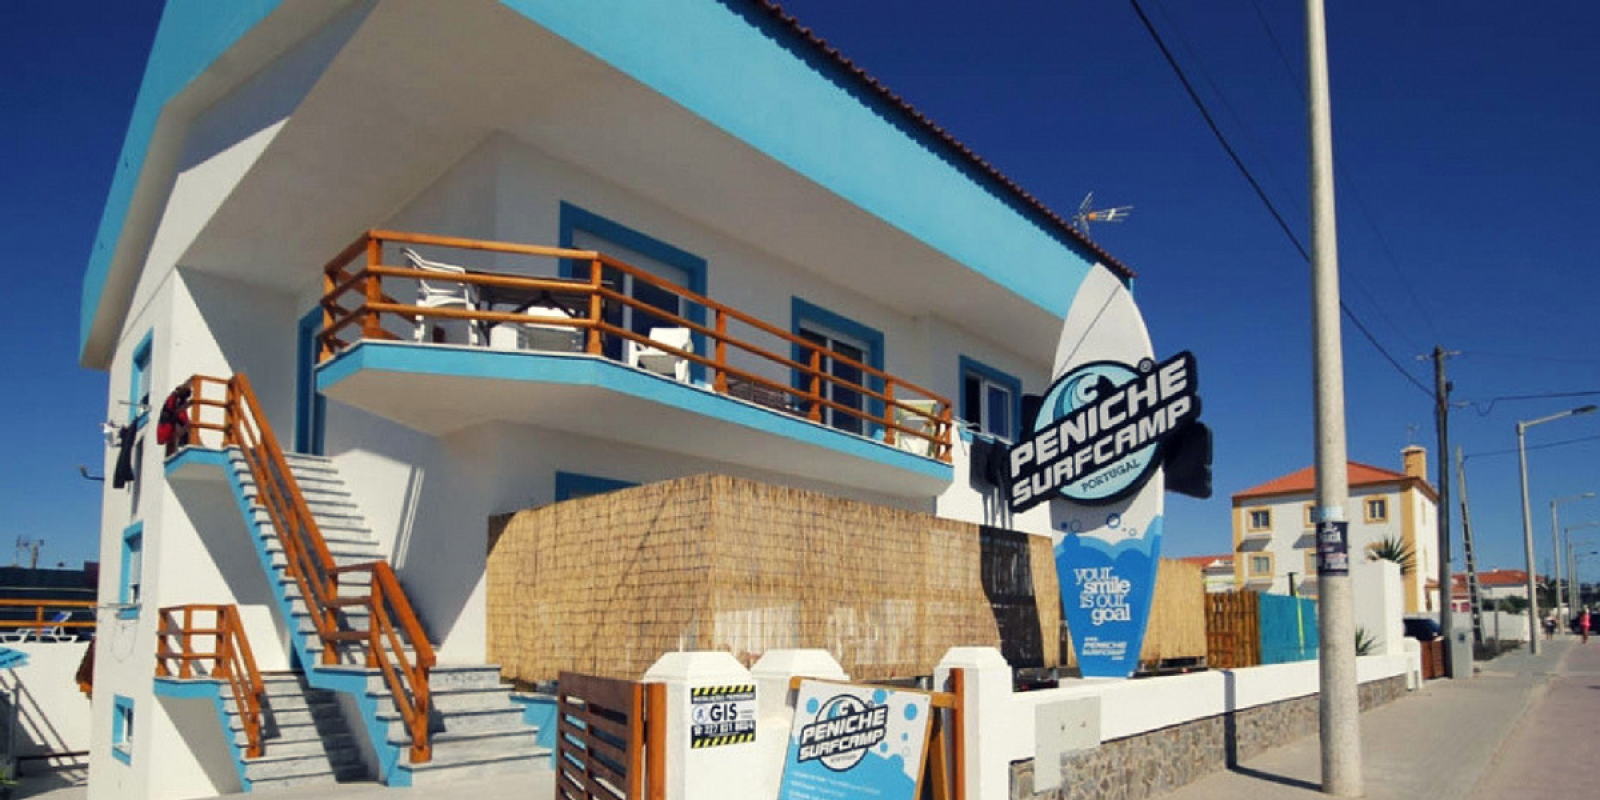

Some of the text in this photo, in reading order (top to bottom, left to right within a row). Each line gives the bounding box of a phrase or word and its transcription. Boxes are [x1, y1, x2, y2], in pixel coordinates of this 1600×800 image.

[1010, 357, 1188, 478] PENICHE
[1012, 396, 1191, 506] SURFCAMP
[1081, 459, 1141, 493] PORTUGAL
[1074, 566, 1113, 585] your
[1083, 576, 1131, 594] smile
[1079, 592, 1126, 608] is our
[1091, 603, 1131, 625] goal
[710, 703, 737, 721] GIS
[802, 706, 887, 745] PENICHE
[800, 727, 885, 758] SURFCAMP
